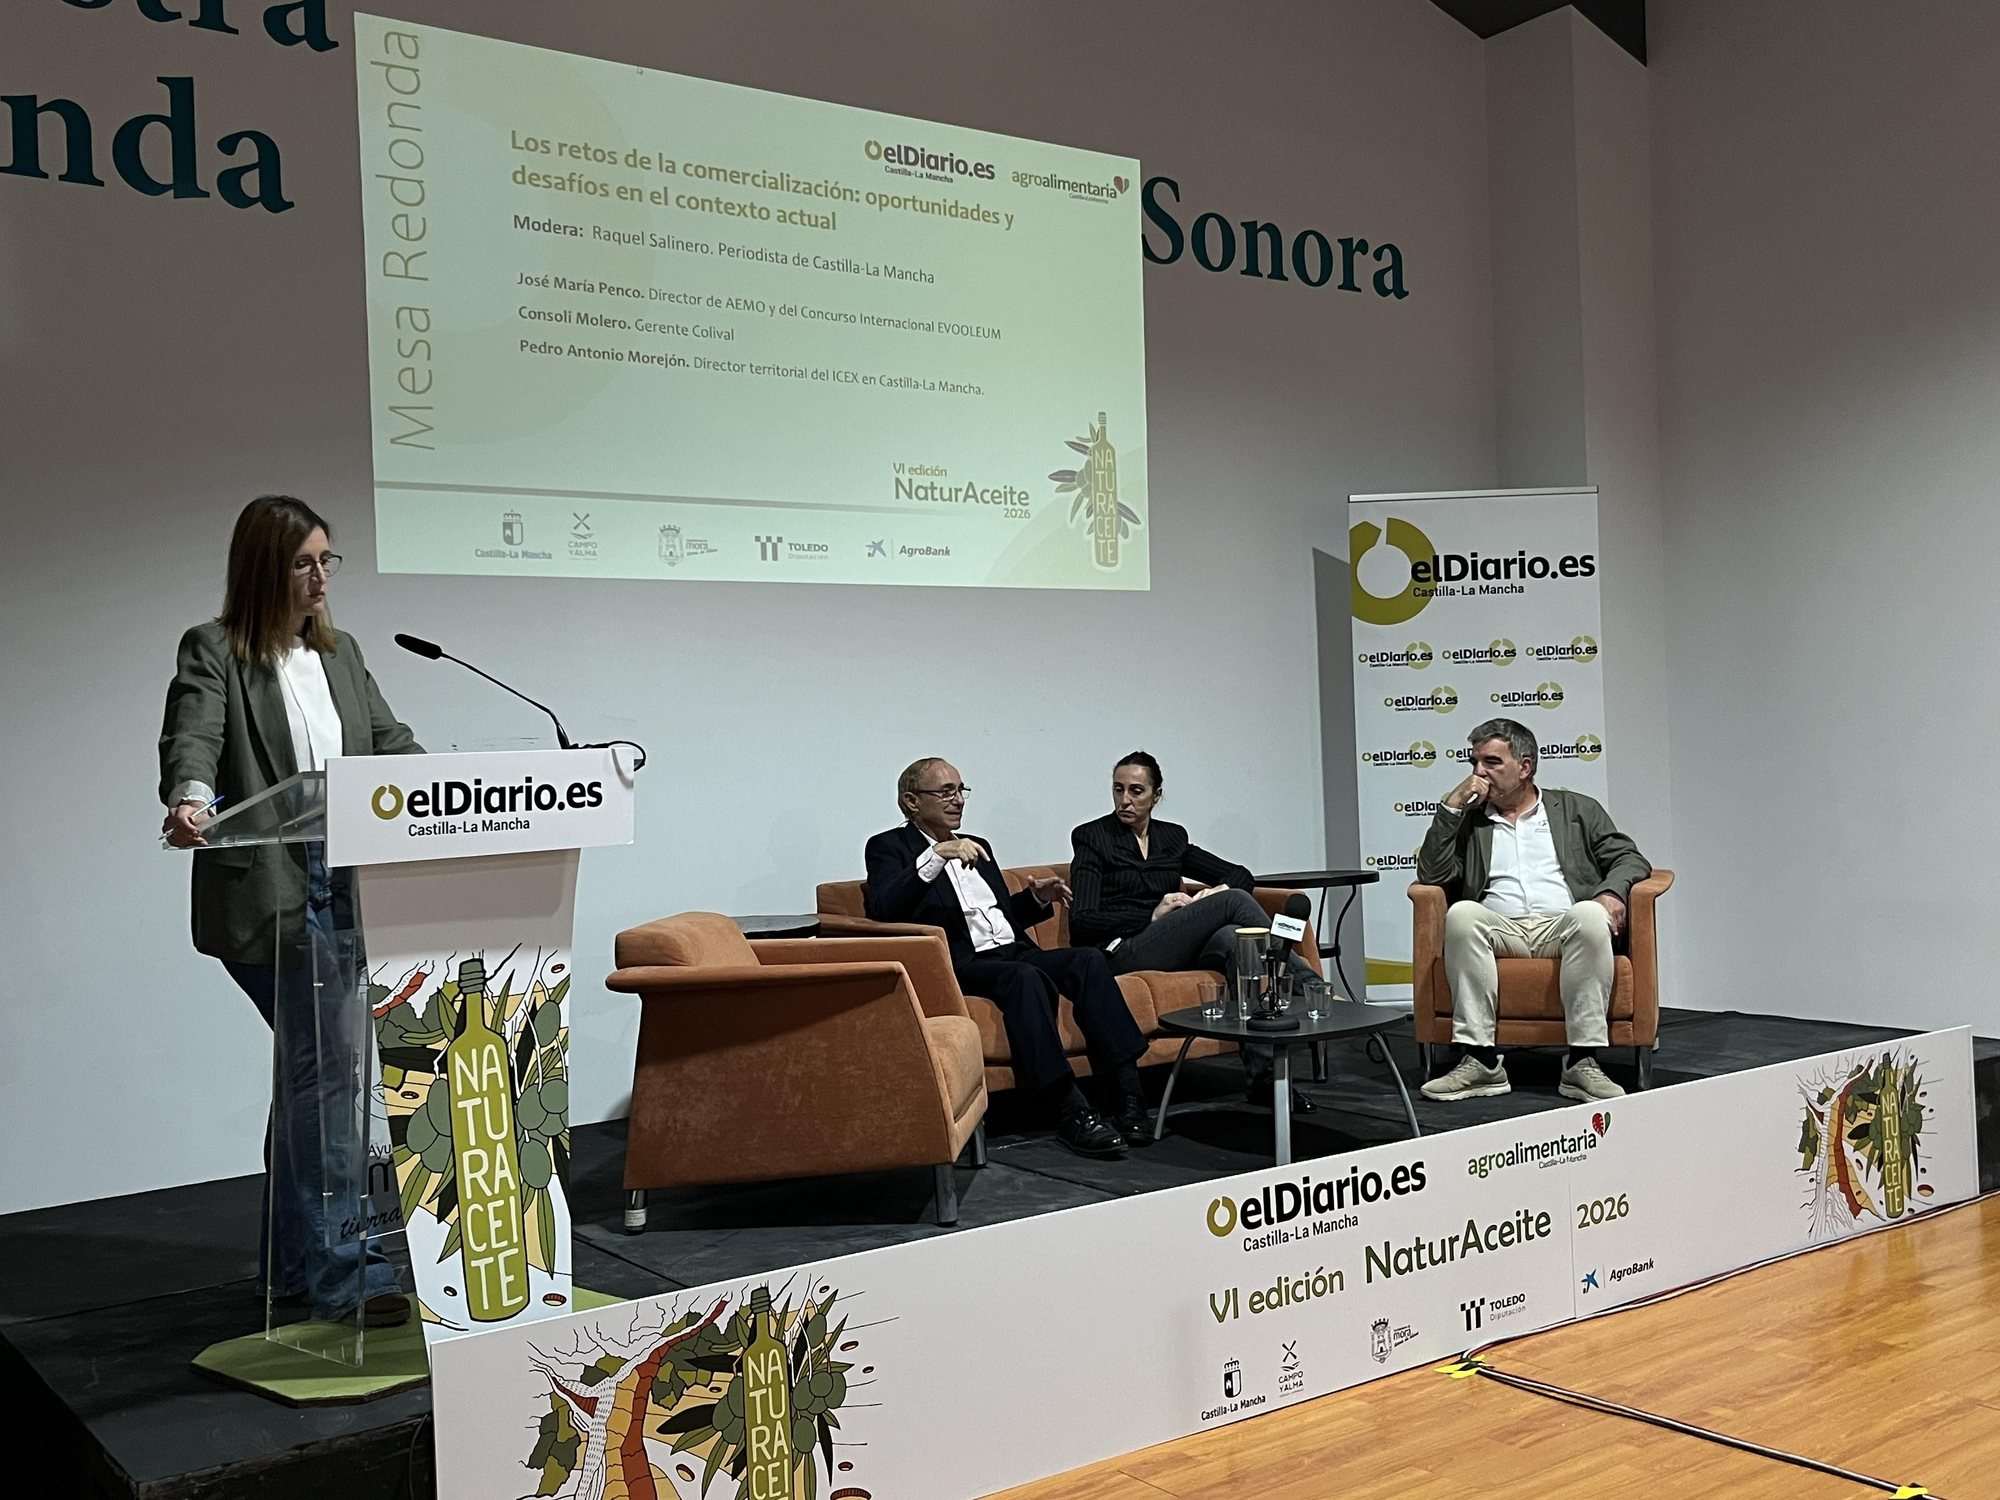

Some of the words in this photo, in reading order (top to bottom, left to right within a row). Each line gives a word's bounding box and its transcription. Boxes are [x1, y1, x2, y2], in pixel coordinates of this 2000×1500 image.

[371, 31, 429, 281] Redonda
[883, 144, 995, 180] elDiario.es
[510, 130, 551, 155] Los
[558, 141, 617, 166] retos
[624, 148, 651, 173] de
[658, 152, 676, 174] la
[682, 162, 861, 204] comercialización:
[865, 190, 1000, 224] oportunidades
[1005, 211, 1015, 231] y
[1012, 171, 1117, 199] agroalimentaria
[512, 165, 609, 198] desafíos
[615, 185, 643, 203] en
[649, 187, 669, 206] el
[675, 194, 770, 222] contexto
[776, 206, 836, 231] actual
[513, 215, 584, 238] Modera:
[593, 225, 645, 246] Raquel
[649, 233, 713, 255] Salinero.
[718, 242, 788, 266] Periodista
[792, 255, 809, 269] de
[813, 255, 880, 278] Castilla-La
[883, 266, 934, 284] Mancha
[1141, 177, 1410, 300] Sonora
[517, 272, 549, 289] José
[553, 276, 595, 294] María
[598, 282, 645, 299] Penco.
[648, 288, 702, 306] Director
[706, 294, 722, 309] de
[725, 297, 765, 314] AEMO
[769, 303, 776, 317] y
[779, 303, 797, 317] del
[801, 306, 857, 324] Concurso
[860, 313, 934, 333] Internacional
[938, 322, 1001, 340] EVOOLEUM
[518, 306, 572, 324] Consoli
[576, 312, 631, 330] Molero.
[635, 318, 688, 336] Gerente
[692, 324, 734, 341] Colival
[389, 305, 435, 450] Mesa
[519, 340, 563, 356] Pedro
[567, 344, 624, 362] Antonio
[627, 349, 689, 369] Morejón.
[693, 356, 746, 373] Director
[749, 362, 807, 380] territorial
[811, 366, 829, 381] del
[832, 369, 859, 384] ICEX
[862, 374, 876, 386] en
[879, 374, 935, 391] Castilla-La
[938, 380, 985, 396] Mancha.
[893, 462, 905, 475] VI
[908, 464, 948, 477] edición
[1095, 449, 1114, 469] NA
[894, 477, 1030, 506] NaturAceite
[1095, 471, 1114, 491] TU
[1003, 508, 1031, 519] 2026
[1096, 492, 1116, 515] RA
[568, 541, 598, 549] CAMPO
[788, 543, 828, 552] TOLEDO
[899, 545, 950, 557] AgroBank
[1097, 539, 1116, 563] TE
[1411, 550, 1596, 583] elDiario.es
[1413, 585, 1476, 598] Castilla-La
[1479, 583, 1525, 596] Mancha
[406, 776, 603, 819] elDiario.es
[408, 821, 478, 837] Castilla-La
[482, 817, 530, 832] Mancha
[454, 1044, 504, 1096] NA
[457, 1093, 508, 1146] TU
[1882, 1091, 1897, 1115] NA
[1883, 1115, 1899, 1138] TU
[1467, 1128, 1597, 1179] agroalimentaria
[1884, 1137, 1900, 1162] RA
[462, 1143, 516, 1200] RA
[1239, 1160, 1426, 1231] elDiario.es
[1886, 1186, 1902, 1213] TE
[466, 1195, 519, 1253] CEI
[1243, 1229, 1308, 1253] Castilla-La
[1312, 1213, 1358, 1235] Mancha
[1210, 1287, 1239, 1324] VI
[1248, 1266, 1344, 1314] edición
[1364, 1208, 1551, 1284] NaturAceite
[1576, 1193, 1630, 1229] 2026
[1609, 1257, 1654, 1283] AgroBank
[471, 1248, 523, 1310] TE
[1489, 1293, 1526, 1311] TOLEDO
[1489, 1305, 1526, 1321] Diputación
[1393, 1328, 1412, 1341] mora
[748, 1349, 784, 1388] NA
[1278, 1370, 1304, 1384] CAMPO
[749, 1384, 785, 1424] TU
[1240, 1394, 1266, 1408] Mancha
[751, 1420, 789, 1463] RA
[752, 1458, 789, 1500] CEI
